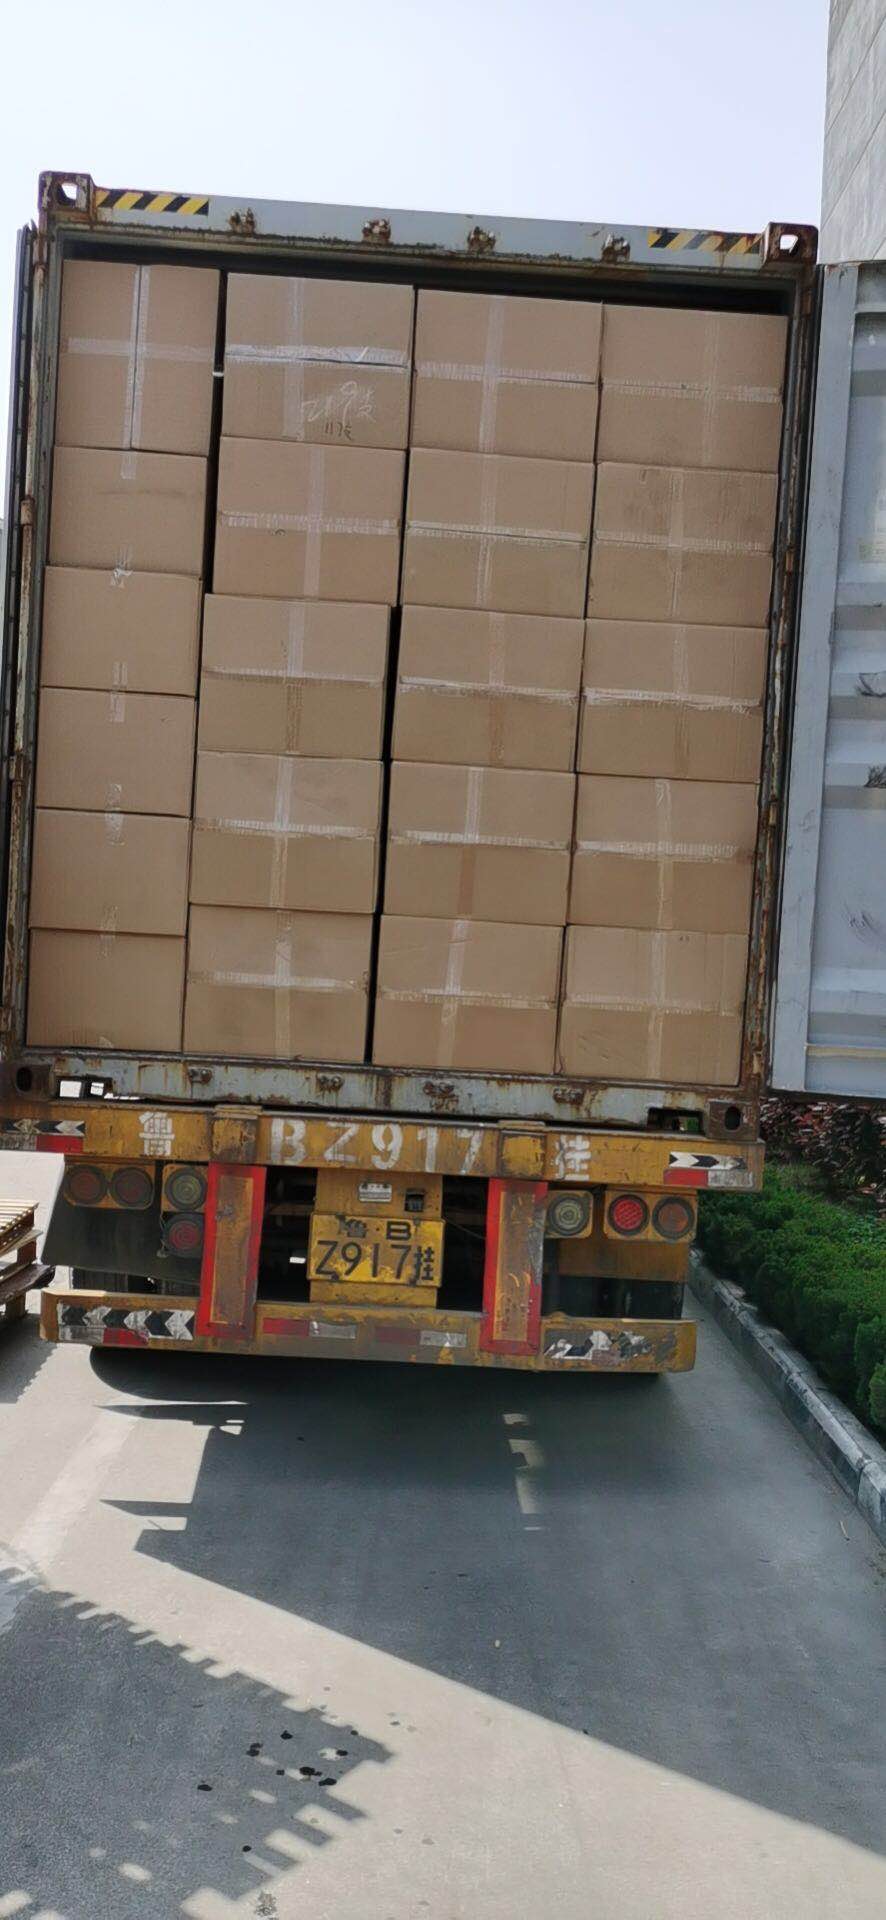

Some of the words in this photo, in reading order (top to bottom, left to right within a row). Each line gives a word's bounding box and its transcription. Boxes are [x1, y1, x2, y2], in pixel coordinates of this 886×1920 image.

[138, 1110, 176, 1156] 鲁
[271, 1117, 486, 1176] BZ917
[554, 1134, 592, 1182] 挂
[315, 1239, 435, 1282] Z917挂
